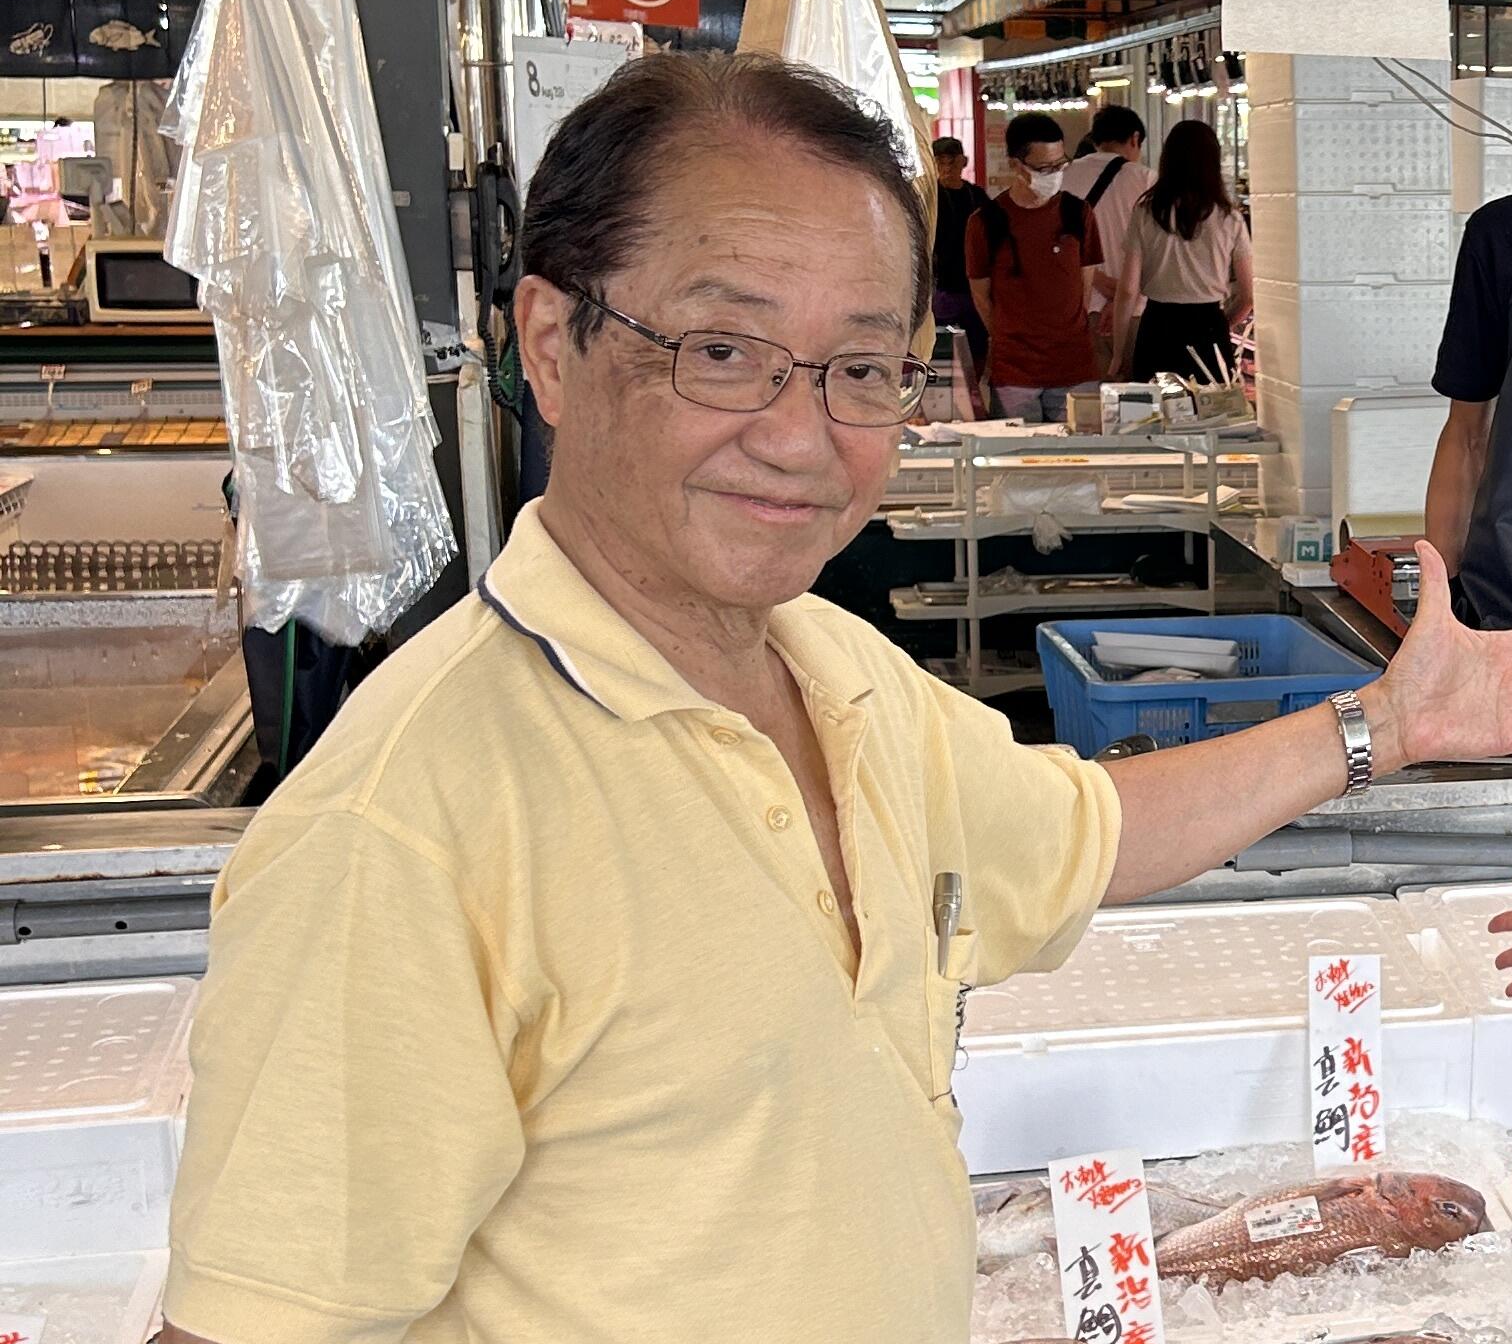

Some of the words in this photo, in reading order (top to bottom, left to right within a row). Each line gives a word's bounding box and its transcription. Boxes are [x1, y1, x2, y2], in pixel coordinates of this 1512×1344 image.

[526, 60, 540, 97] 8
[1313, 1045, 1350, 1152] 真鯛
[1342, 1037, 1383, 1162] 新潟産
